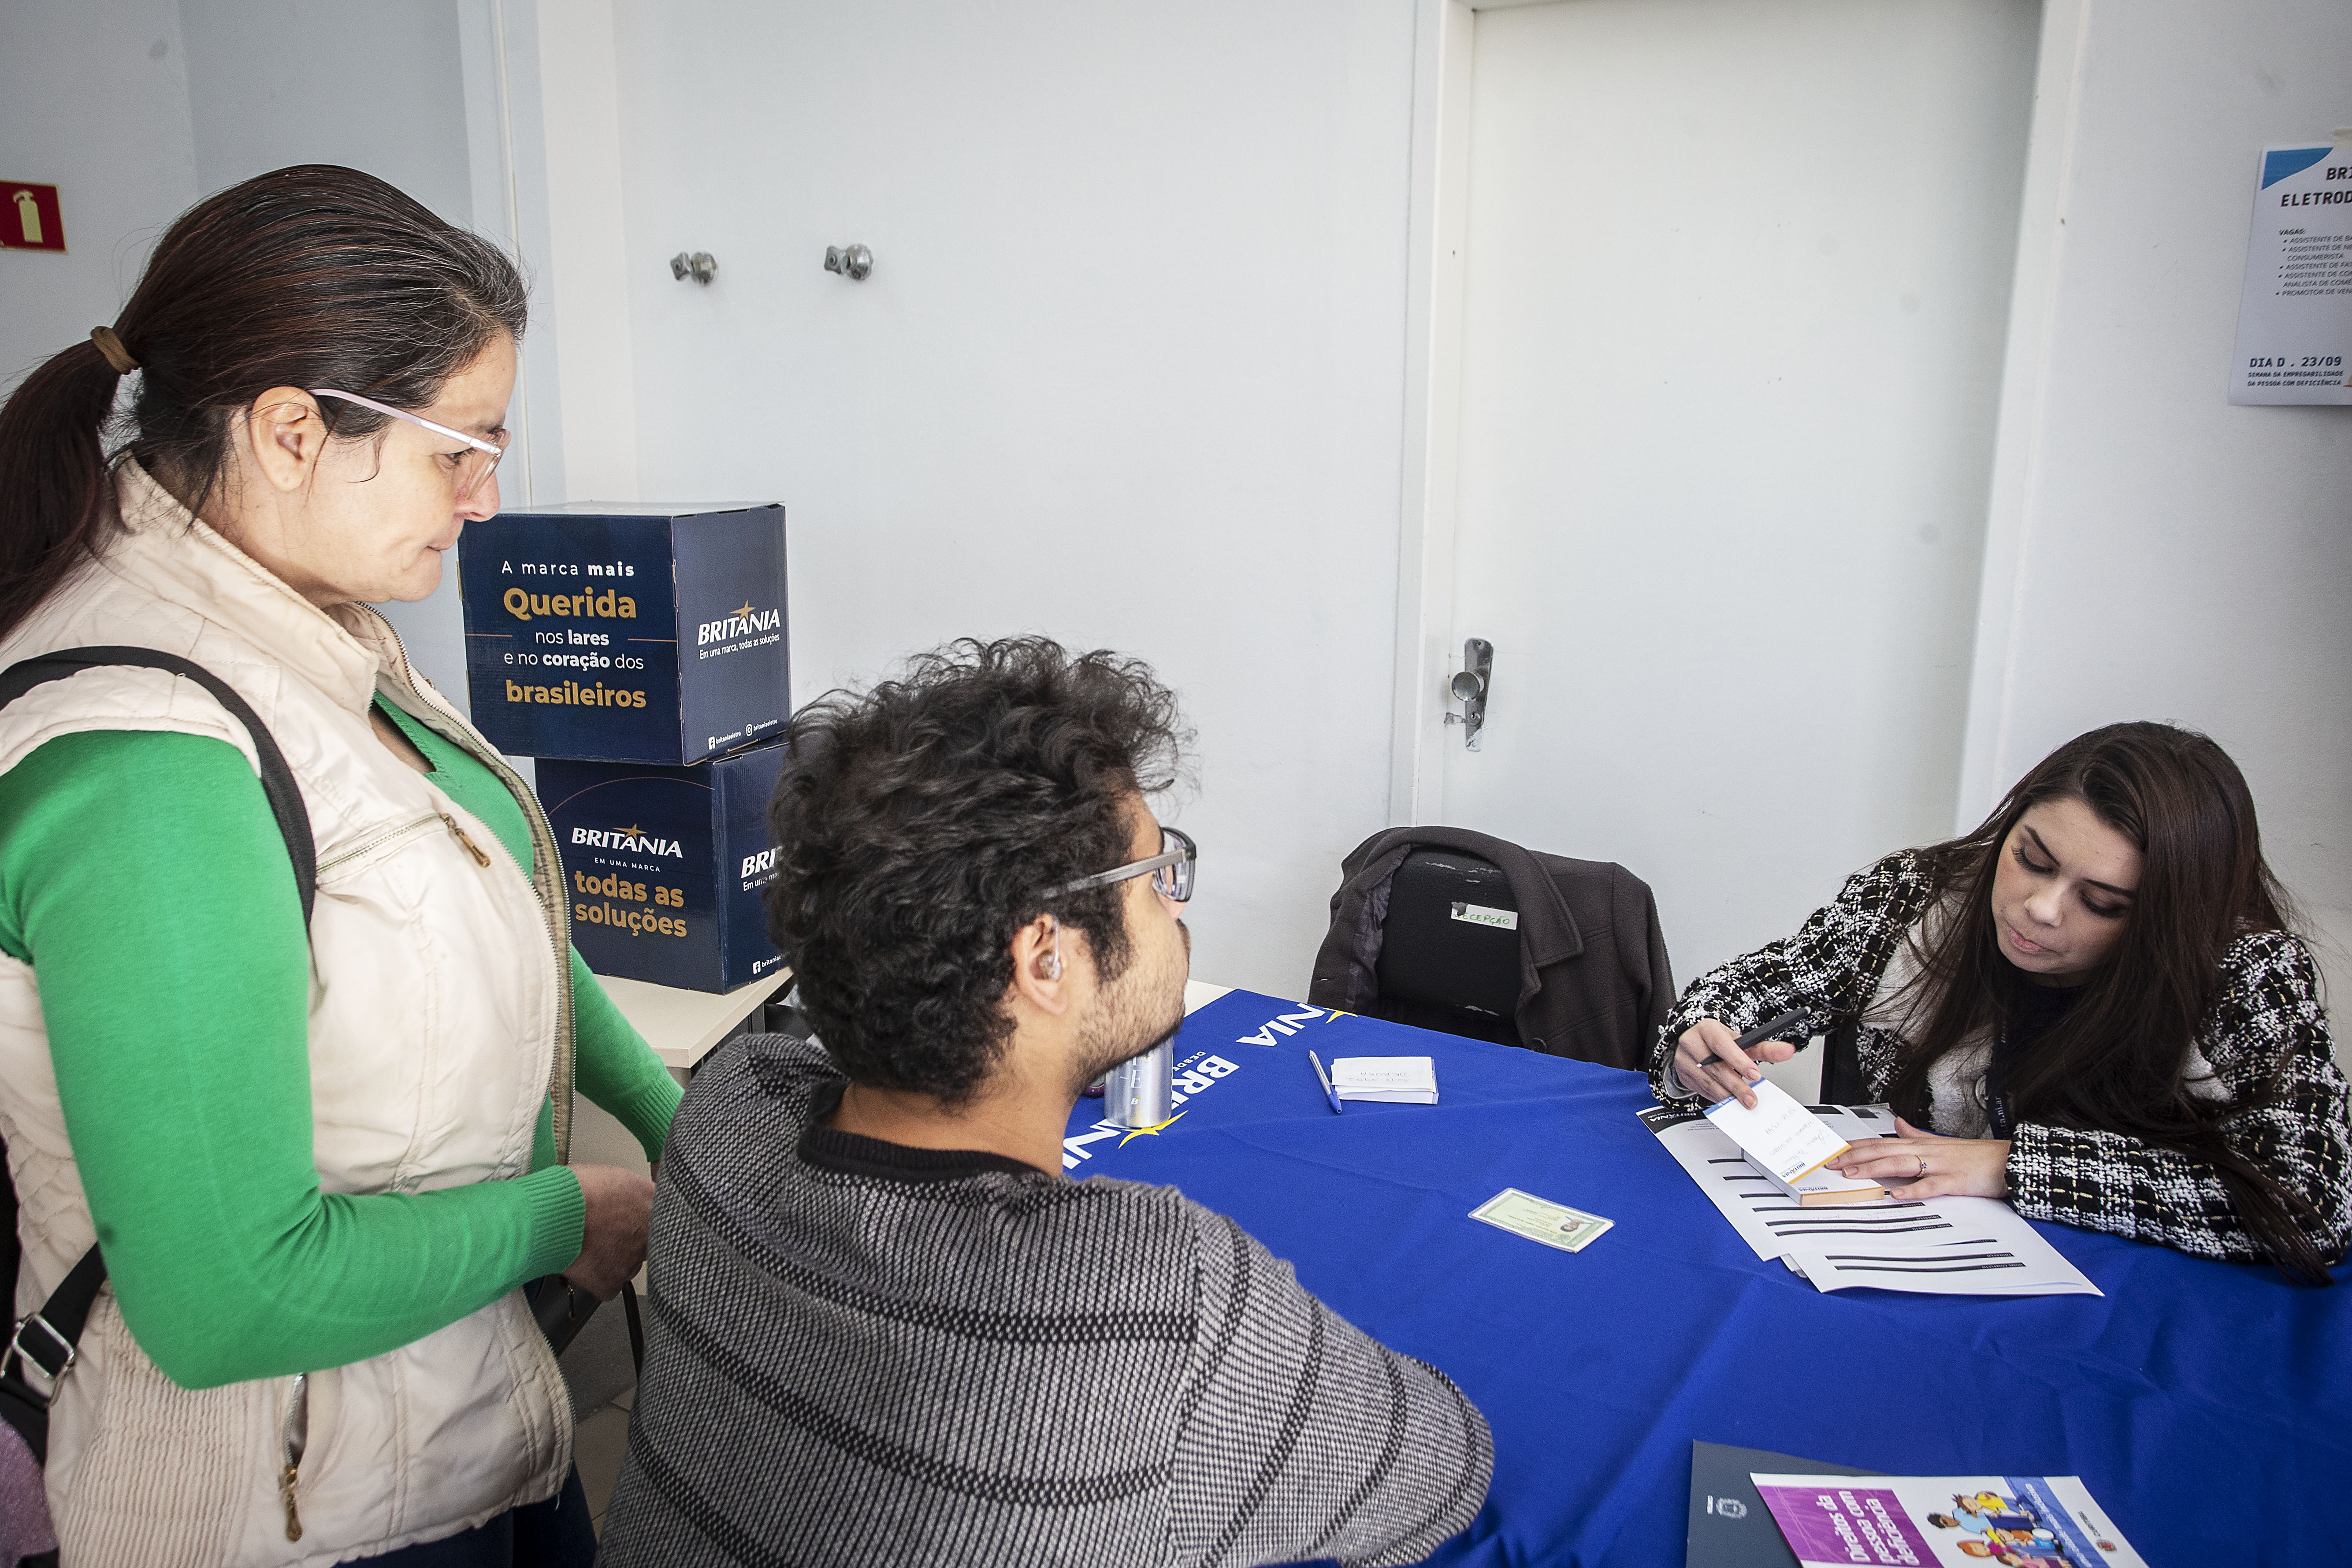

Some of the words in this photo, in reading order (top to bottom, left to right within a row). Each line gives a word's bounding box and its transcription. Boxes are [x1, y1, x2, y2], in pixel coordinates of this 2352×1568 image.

[2281, 191, 2352, 207] ELETROD
[2250, 357, 2273, 367] DIA
[2277, 357, 2285, 367] D
[2301, 356, 2342, 367] 23/09
[502, 561, 513, 574] A
[522, 564, 578, 575] marca
[588, 561, 634, 576] mais
[504, 586, 636, 621] Querida
[536, 632, 563, 644] nos
[568, 629, 609, 646] lares
[698, 609, 780, 646] BRITANIA
[700, 649, 709, 660] Em
[710, 649, 721, 657] uma
[721, 644, 738, 654] marca,
[739, 639, 753, 650] todas
[759, 633, 780, 645] soluções
[504, 653, 513, 664] e
[518, 653, 538, 665] no
[542, 652, 610, 671] coração
[615, 654, 644, 669] dos
[506, 679, 646, 708] brasileiros
[753, 719, 778, 731] britaniaeletro
[716, 731, 741, 744] britaniaeletro
[572, 827, 683, 858] BRITANIA
[632, 863, 660, 872] MARCA
[741, 846, 780, 878] BRI
[575, 870, 647, 902] todas
[655, 886, 684, 907] as
[743, 881, 754, 891] Em
[575, 902, 687, 937] soluções
[1456, 912, 1510, 925] ECEPÇÃO
[762, 955, 783, 967] britaniae
[1235, 1003, 1326, 1046] NIA
[1172, 1052, 1206, 1071] DESDE
[1816, 1494, 1838, 1512] da
[1838, 1490, 1865, 1518] com
[1829, 1512, 1871, 1562] Direitos
[1857, 1519, 1901, 1565] pessoa
[1865, 1498, 1920, 1566] deficiência
